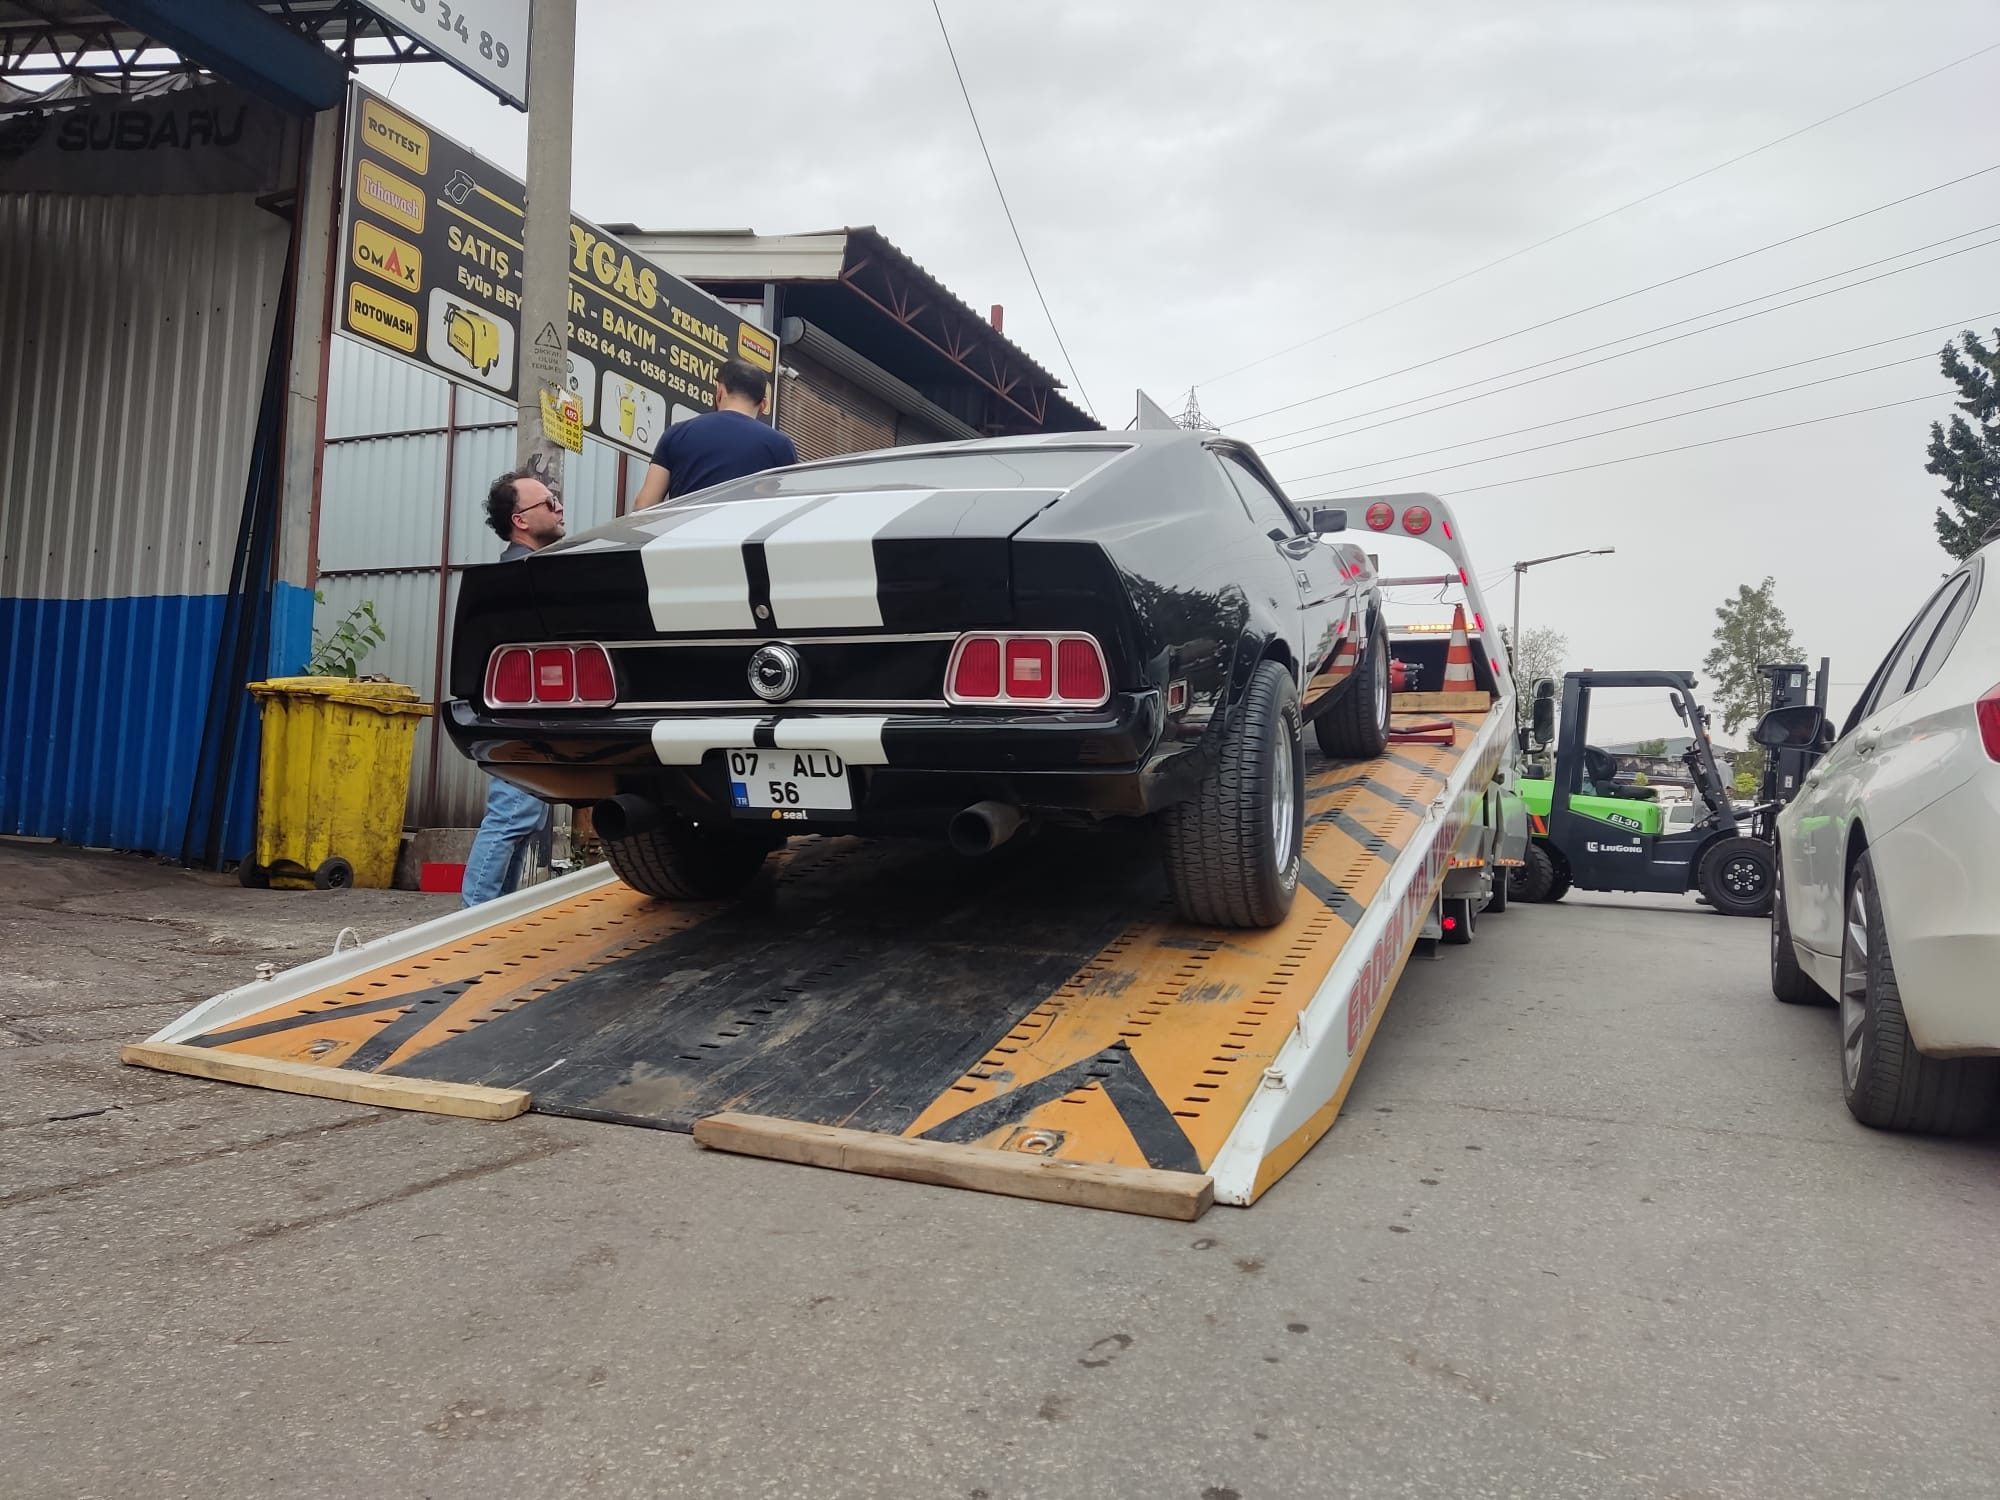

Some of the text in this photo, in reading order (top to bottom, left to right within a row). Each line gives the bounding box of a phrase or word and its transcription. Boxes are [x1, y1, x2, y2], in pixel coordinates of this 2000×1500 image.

[438, 1, 510, 69] 34 89
[57, 104, 248, 152] SUBARU
[368, 117, 421, 157] ROTTEST
[364, 176, 420, 220] Tahawash
[448, 225, 509, 279] SATIŞ
[602, 307, 656, 355] BAKIM
[570, 223, 658, 310] YGAS
[671, 306, 729, 353] TEKNİK
[354, 299, 413, 336] ROTOWASH
[458, 265, 492, 299] Eyüp
[601, 339, 615, 358] 64
[668, 373, 686, 392] 255
[687, 383, 699, 400] 82
[731, 752, 844, 778] 07 ALU
[736, 797, 748, 805] TR
[769, 781, 800, 804] 56
[782, 809, 808, 820] seal
[1611, 814, 1640, 828] EL30
[1347, 895, 1405, 1057] ERDEM
